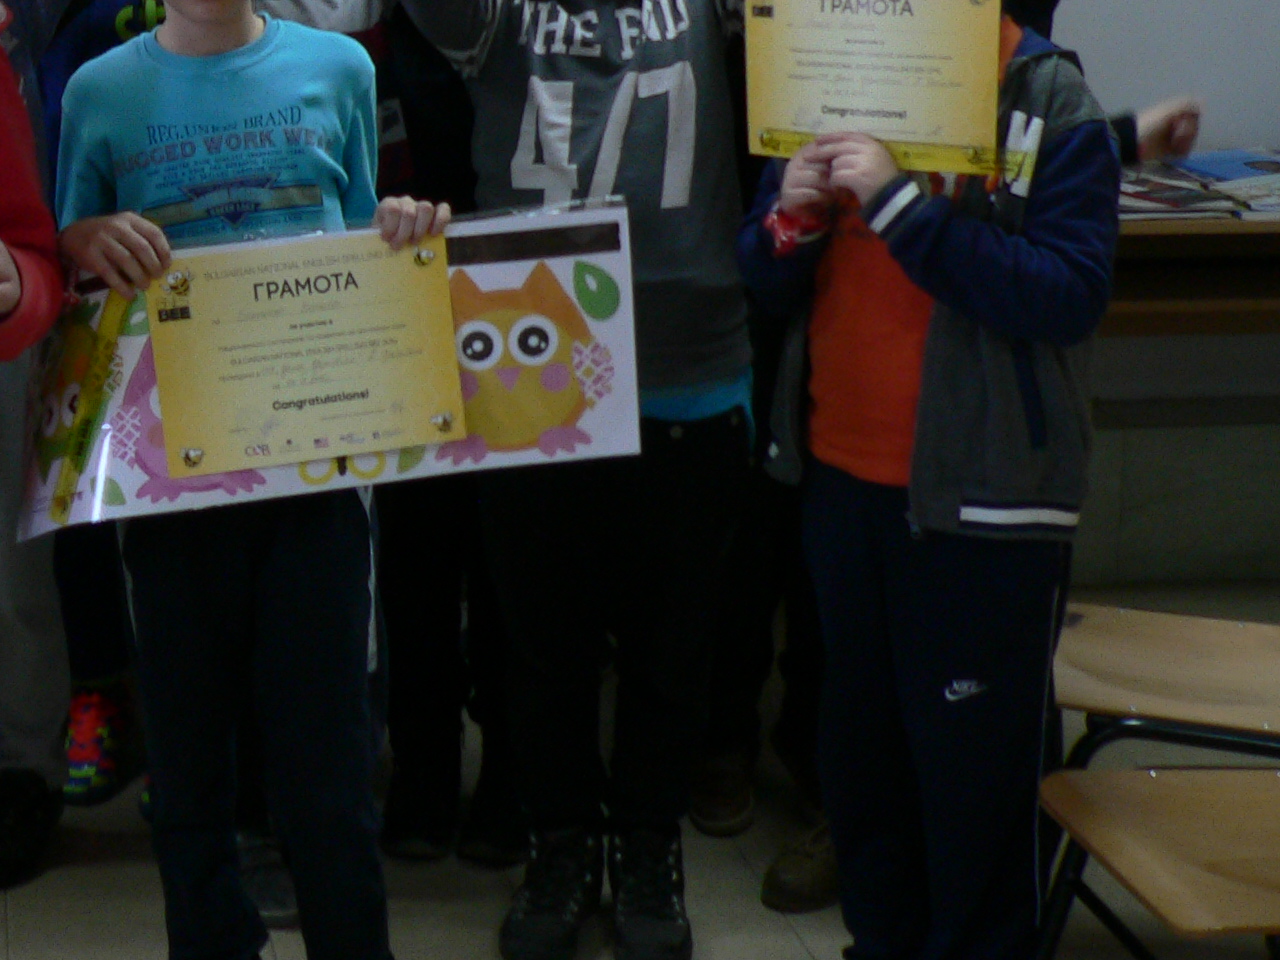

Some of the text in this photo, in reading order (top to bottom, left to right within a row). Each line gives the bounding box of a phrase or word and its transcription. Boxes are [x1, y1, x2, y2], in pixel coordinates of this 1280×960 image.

[244, 106, 302, 129] BRAND
[202, 128, 275, 154] WORK
[253, 271, 359, 302] ГРАМОТА
[272, 388, 370, 411] Congratulations!
